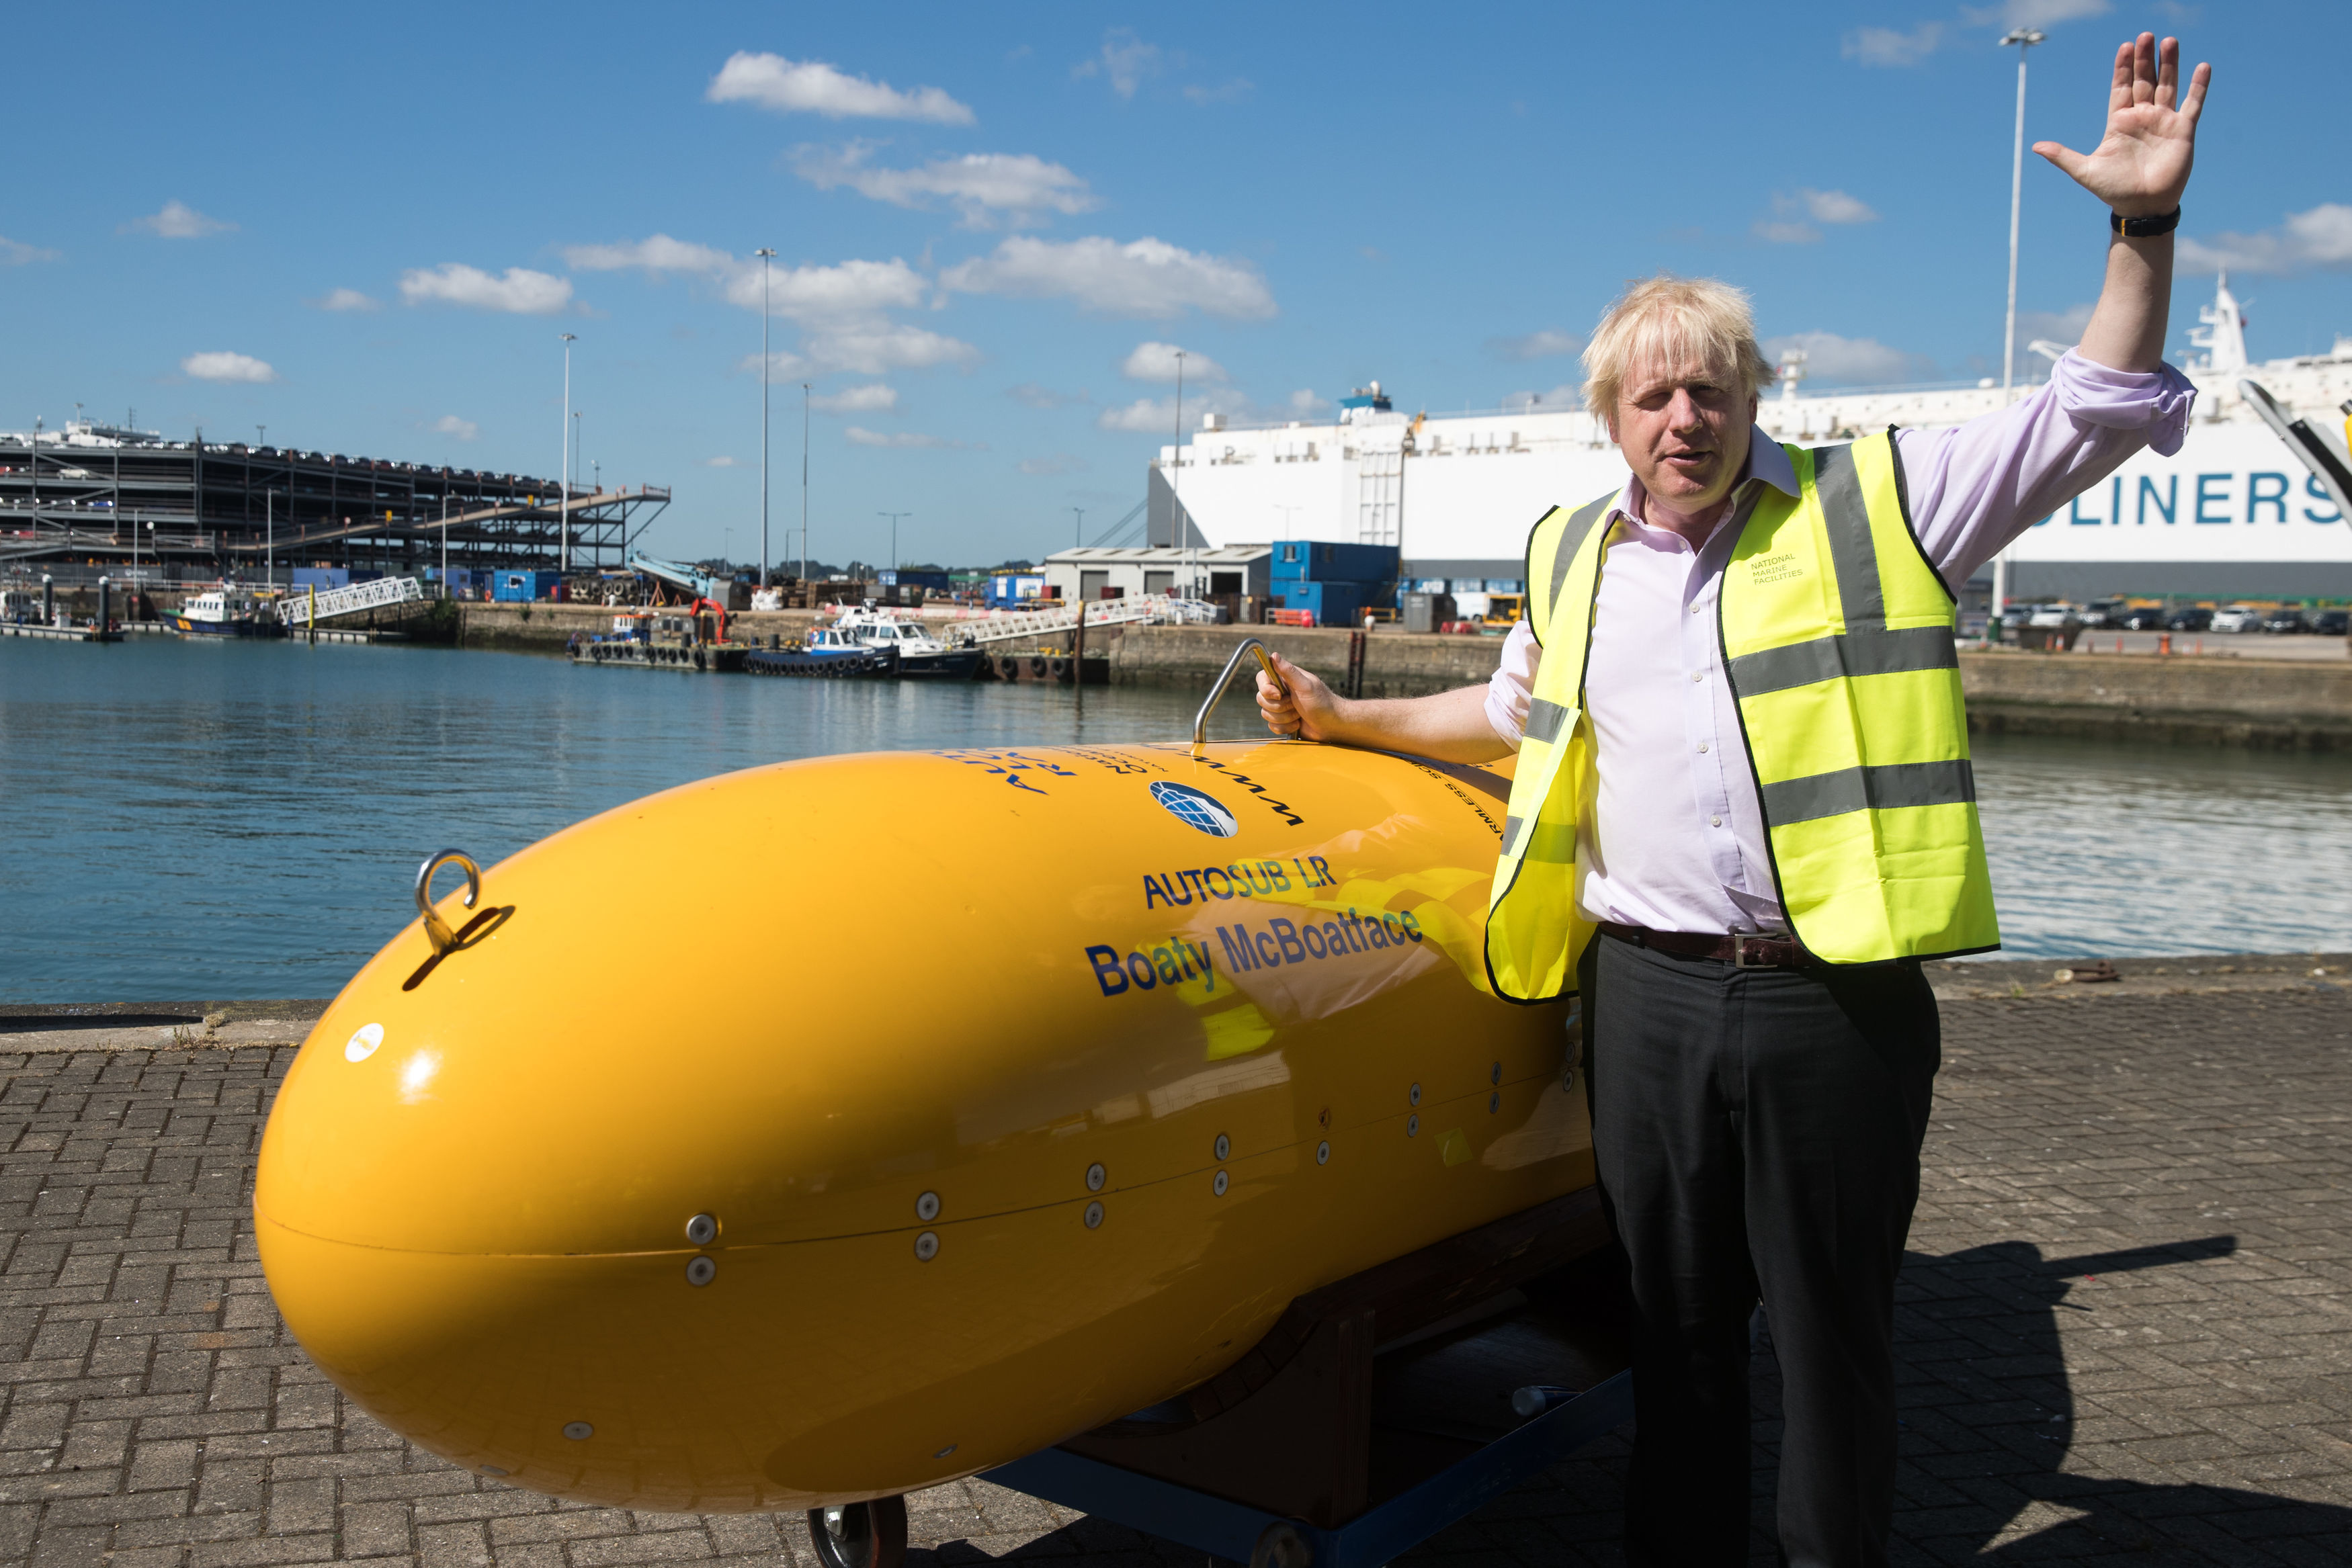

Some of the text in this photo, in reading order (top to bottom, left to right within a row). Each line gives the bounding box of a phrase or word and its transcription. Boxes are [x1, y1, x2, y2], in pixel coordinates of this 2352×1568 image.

[2032, 472, 2343, 527] LINERS
[1752, 554, 1796, 569] NATIONAL
[1753, 565, 1787, 576] MARINE
[1755, 570, 1803, 584] FACILITIES
[1143, 855, 1337, 910] AUTOSUB LR
[1085, 907, 1423, 997] Boaty McBoatface
